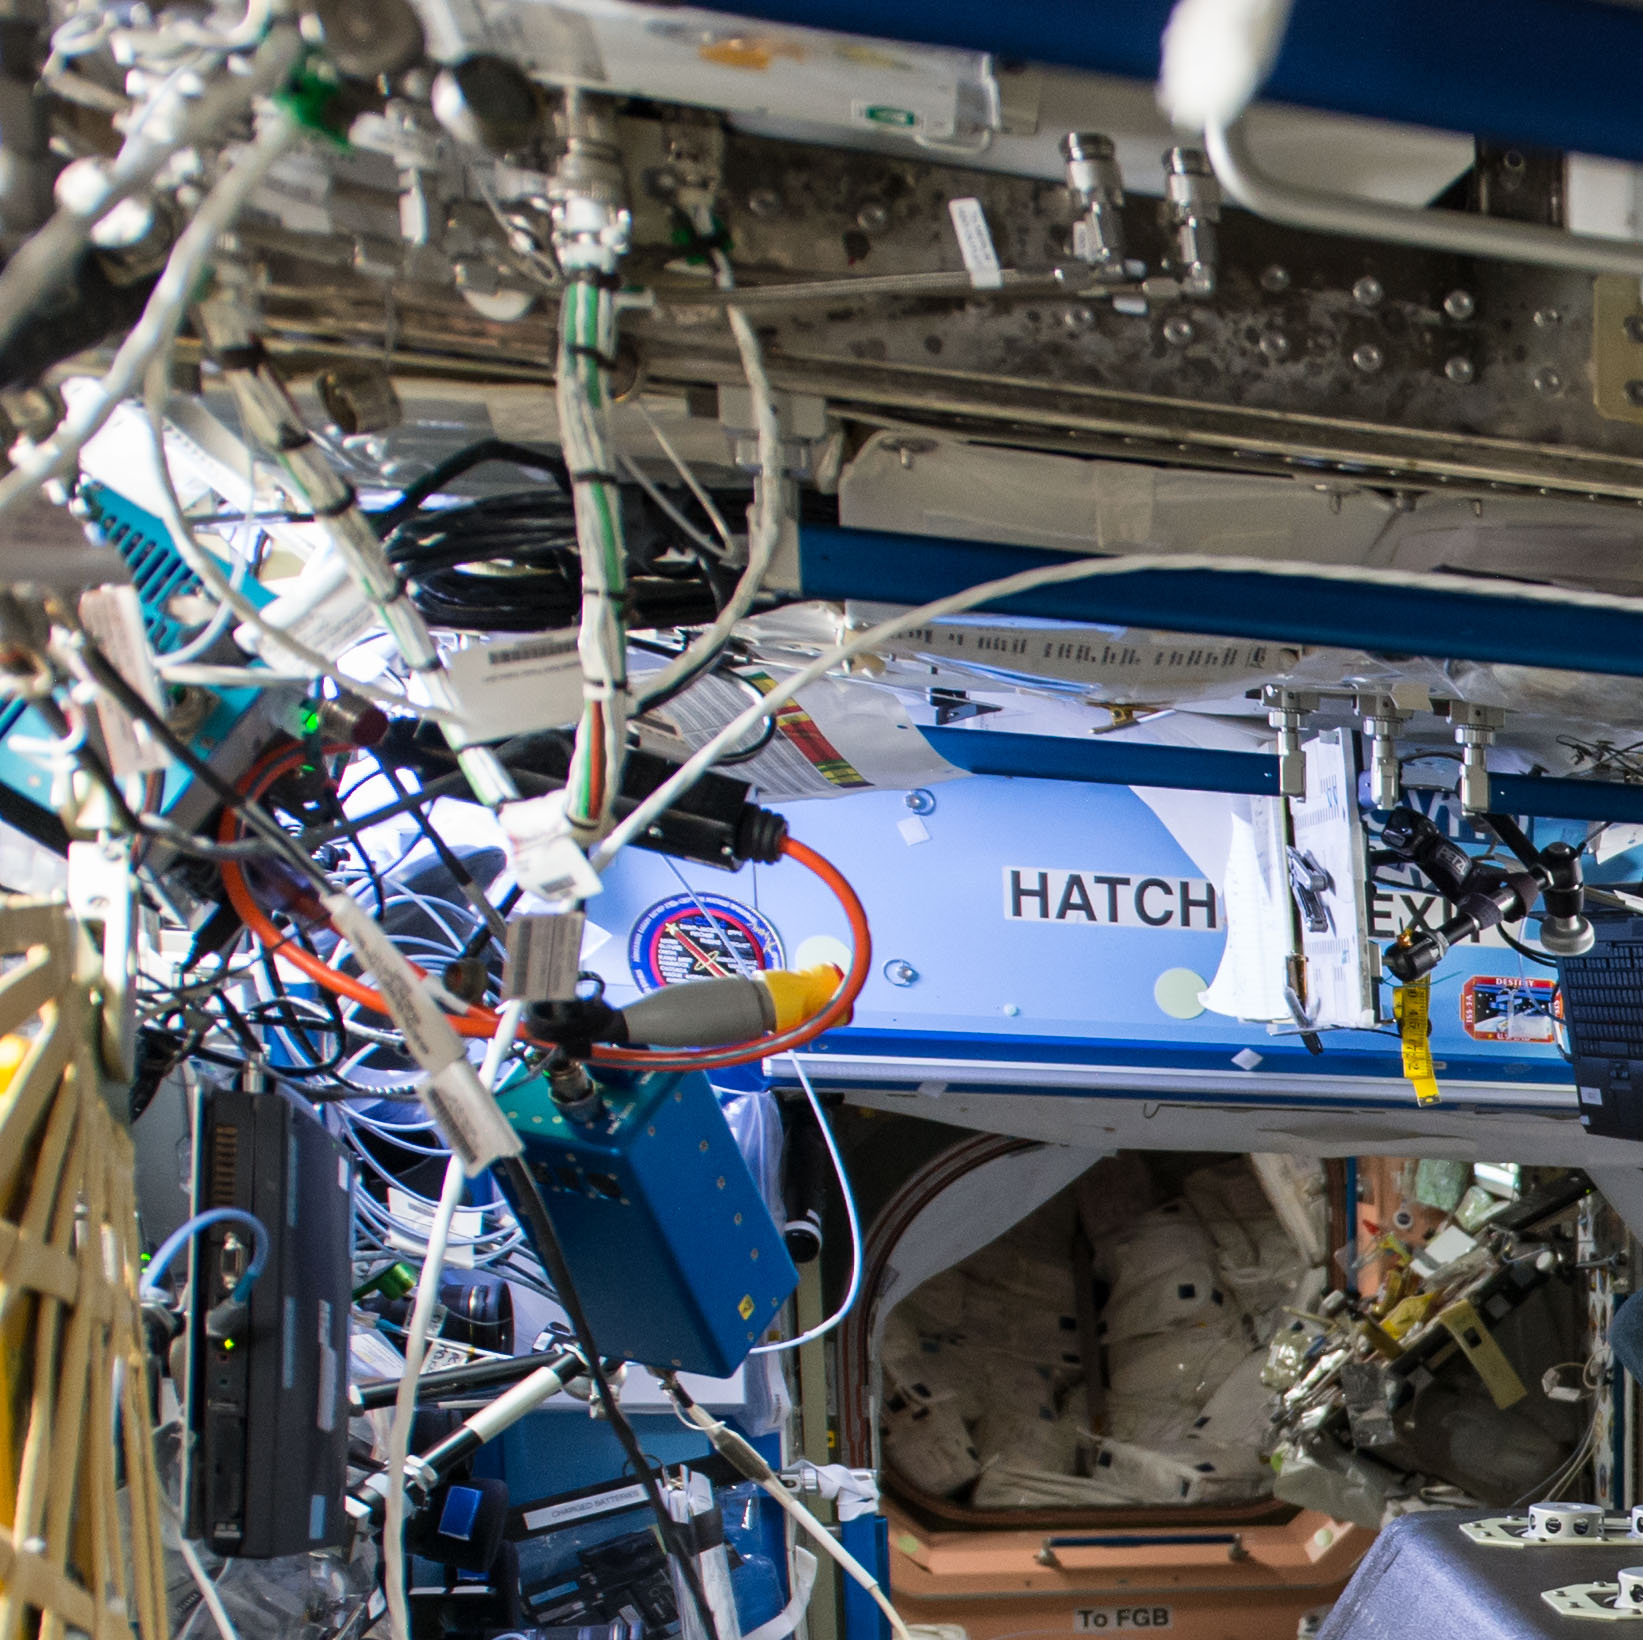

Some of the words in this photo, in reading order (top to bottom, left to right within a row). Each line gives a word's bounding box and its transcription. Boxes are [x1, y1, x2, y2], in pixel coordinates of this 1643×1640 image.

[1011, 870, 1217, 929] HATCH
[1374, 892, 1481, 944] EXI
[551, 1502, 593, 1518] CHARGED
[595, 1490, 640, 1506] BATTERIES
[1078, 1609, 1109, 1630] To
[1116, 1608, 1169, 1630] FGB
